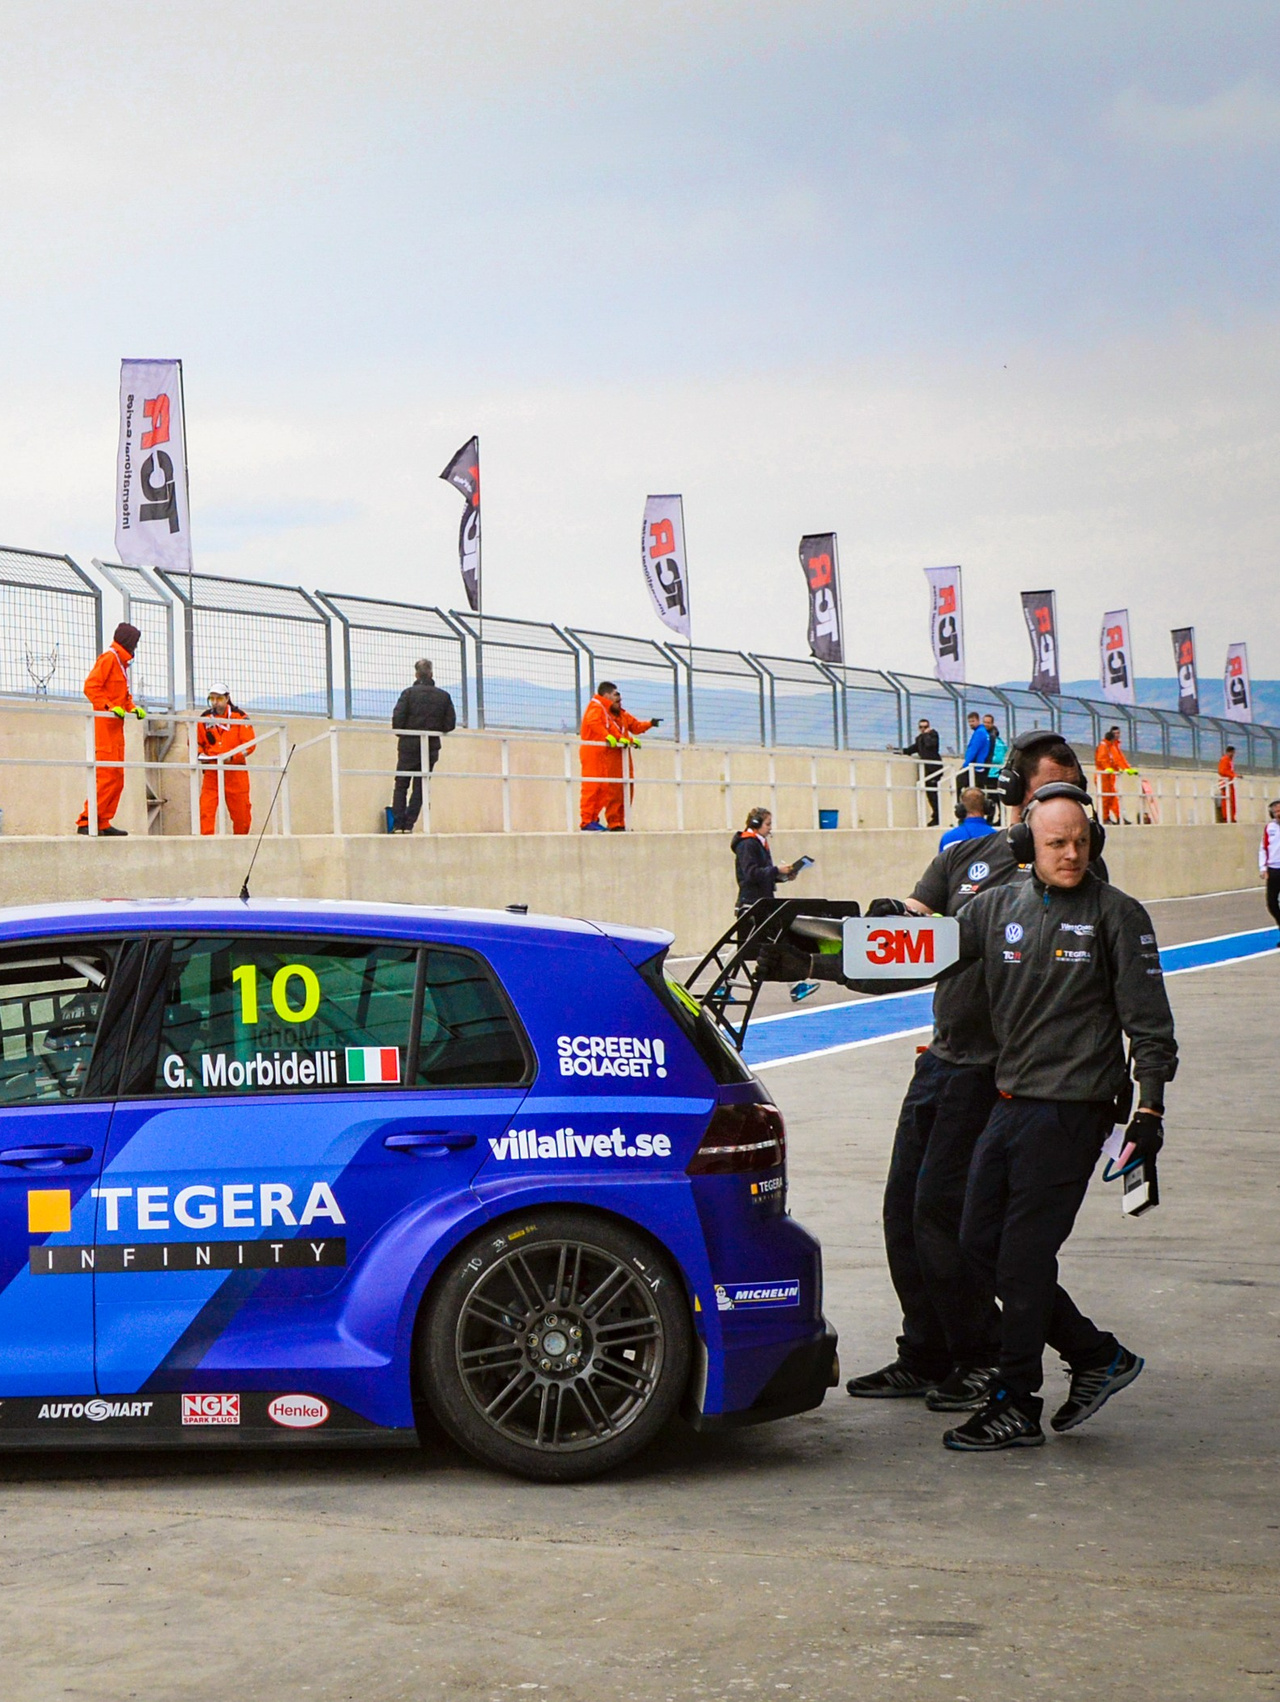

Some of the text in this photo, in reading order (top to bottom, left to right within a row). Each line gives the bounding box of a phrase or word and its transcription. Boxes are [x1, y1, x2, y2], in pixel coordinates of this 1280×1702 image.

[866, 929, 934, 965] 3M
[232, 964, 320, 1024] 10
[557, 1036, 651, 1058] SCREEN
[163, 1050, 338, 1088] G. Morbidelli
[488, 1127, 672, 1160] villalivet.se
[91, 1182, 346, 1231] TEGERA
[47, 1243, 325, 1269] INFINITY
[735, 1287, 798, 1300] MICHELIN
[184, 1396, 238, 1416] NGK
[273, 1404, 323, 1418] Henkel
